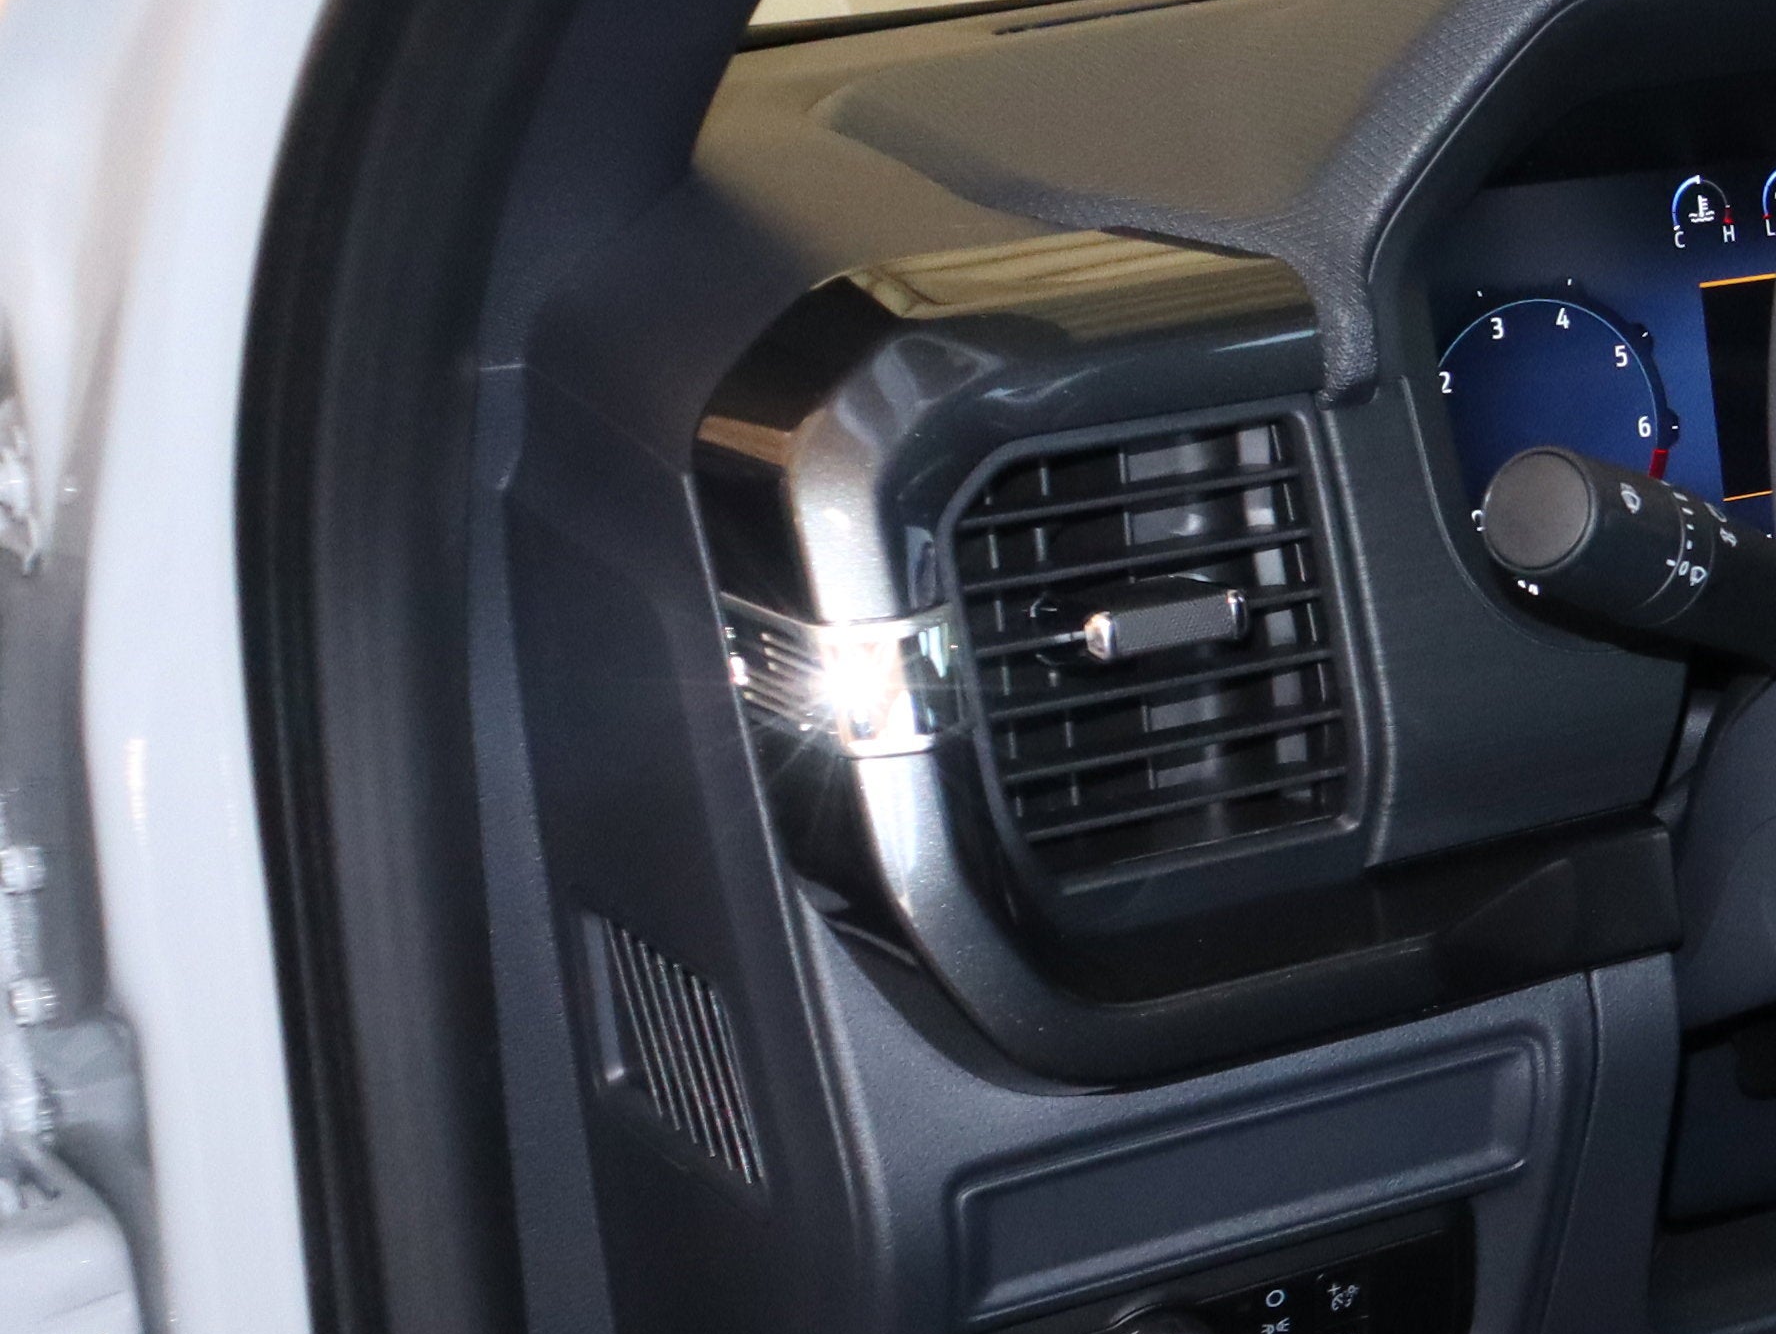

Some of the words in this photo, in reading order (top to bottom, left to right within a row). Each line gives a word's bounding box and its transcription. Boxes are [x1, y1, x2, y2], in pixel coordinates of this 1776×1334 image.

[1722, 224, 1736, 243] H
[1490, 317, 1505, 340] 3
[1555, 307, 1570, 329] 4
[1614, 345, 1629, 367] 5
[1438, 371, 1452, 394] 2
[1637, 415, 1652, 438] 6
